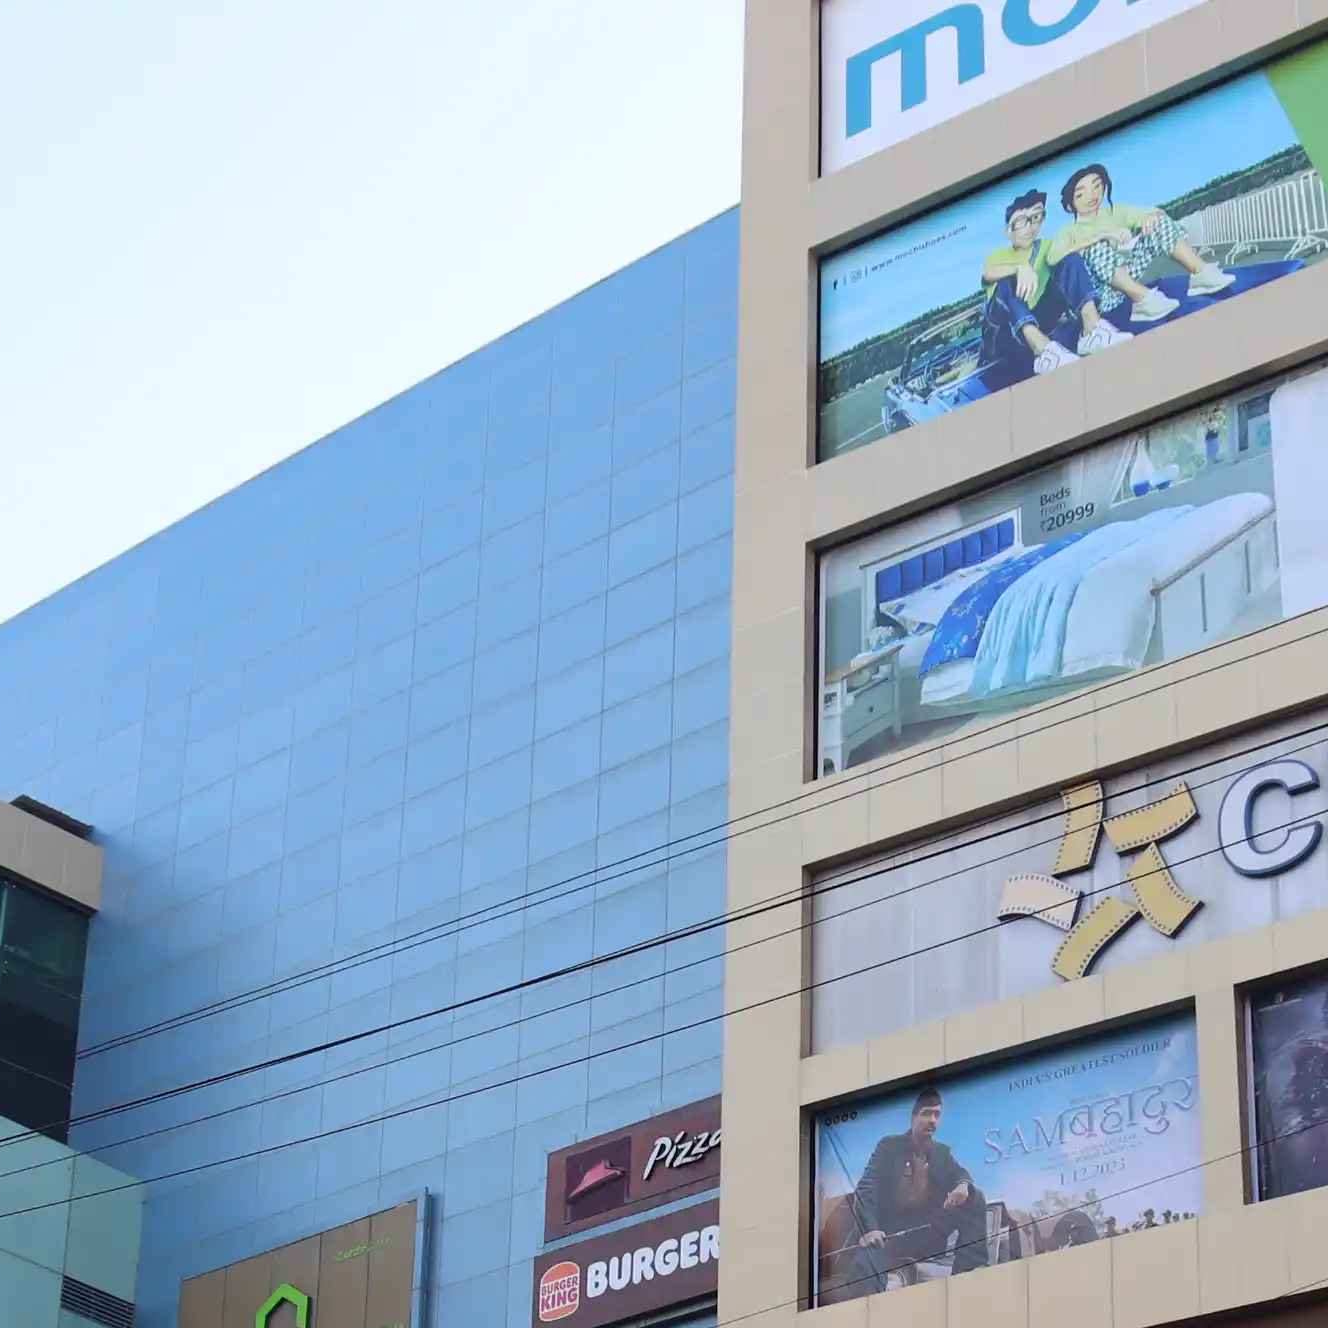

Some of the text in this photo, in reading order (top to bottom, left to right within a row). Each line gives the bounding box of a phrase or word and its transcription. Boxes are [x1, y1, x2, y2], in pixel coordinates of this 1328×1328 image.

[846, 0, 1140, 138] mo
[1040, 487, 1072, 506] Beds
[586, 1224, 719, 1299] BURGER
[541, 1275, 579, 1297] BURGER
[540, 1287, 578, 1312] KING
